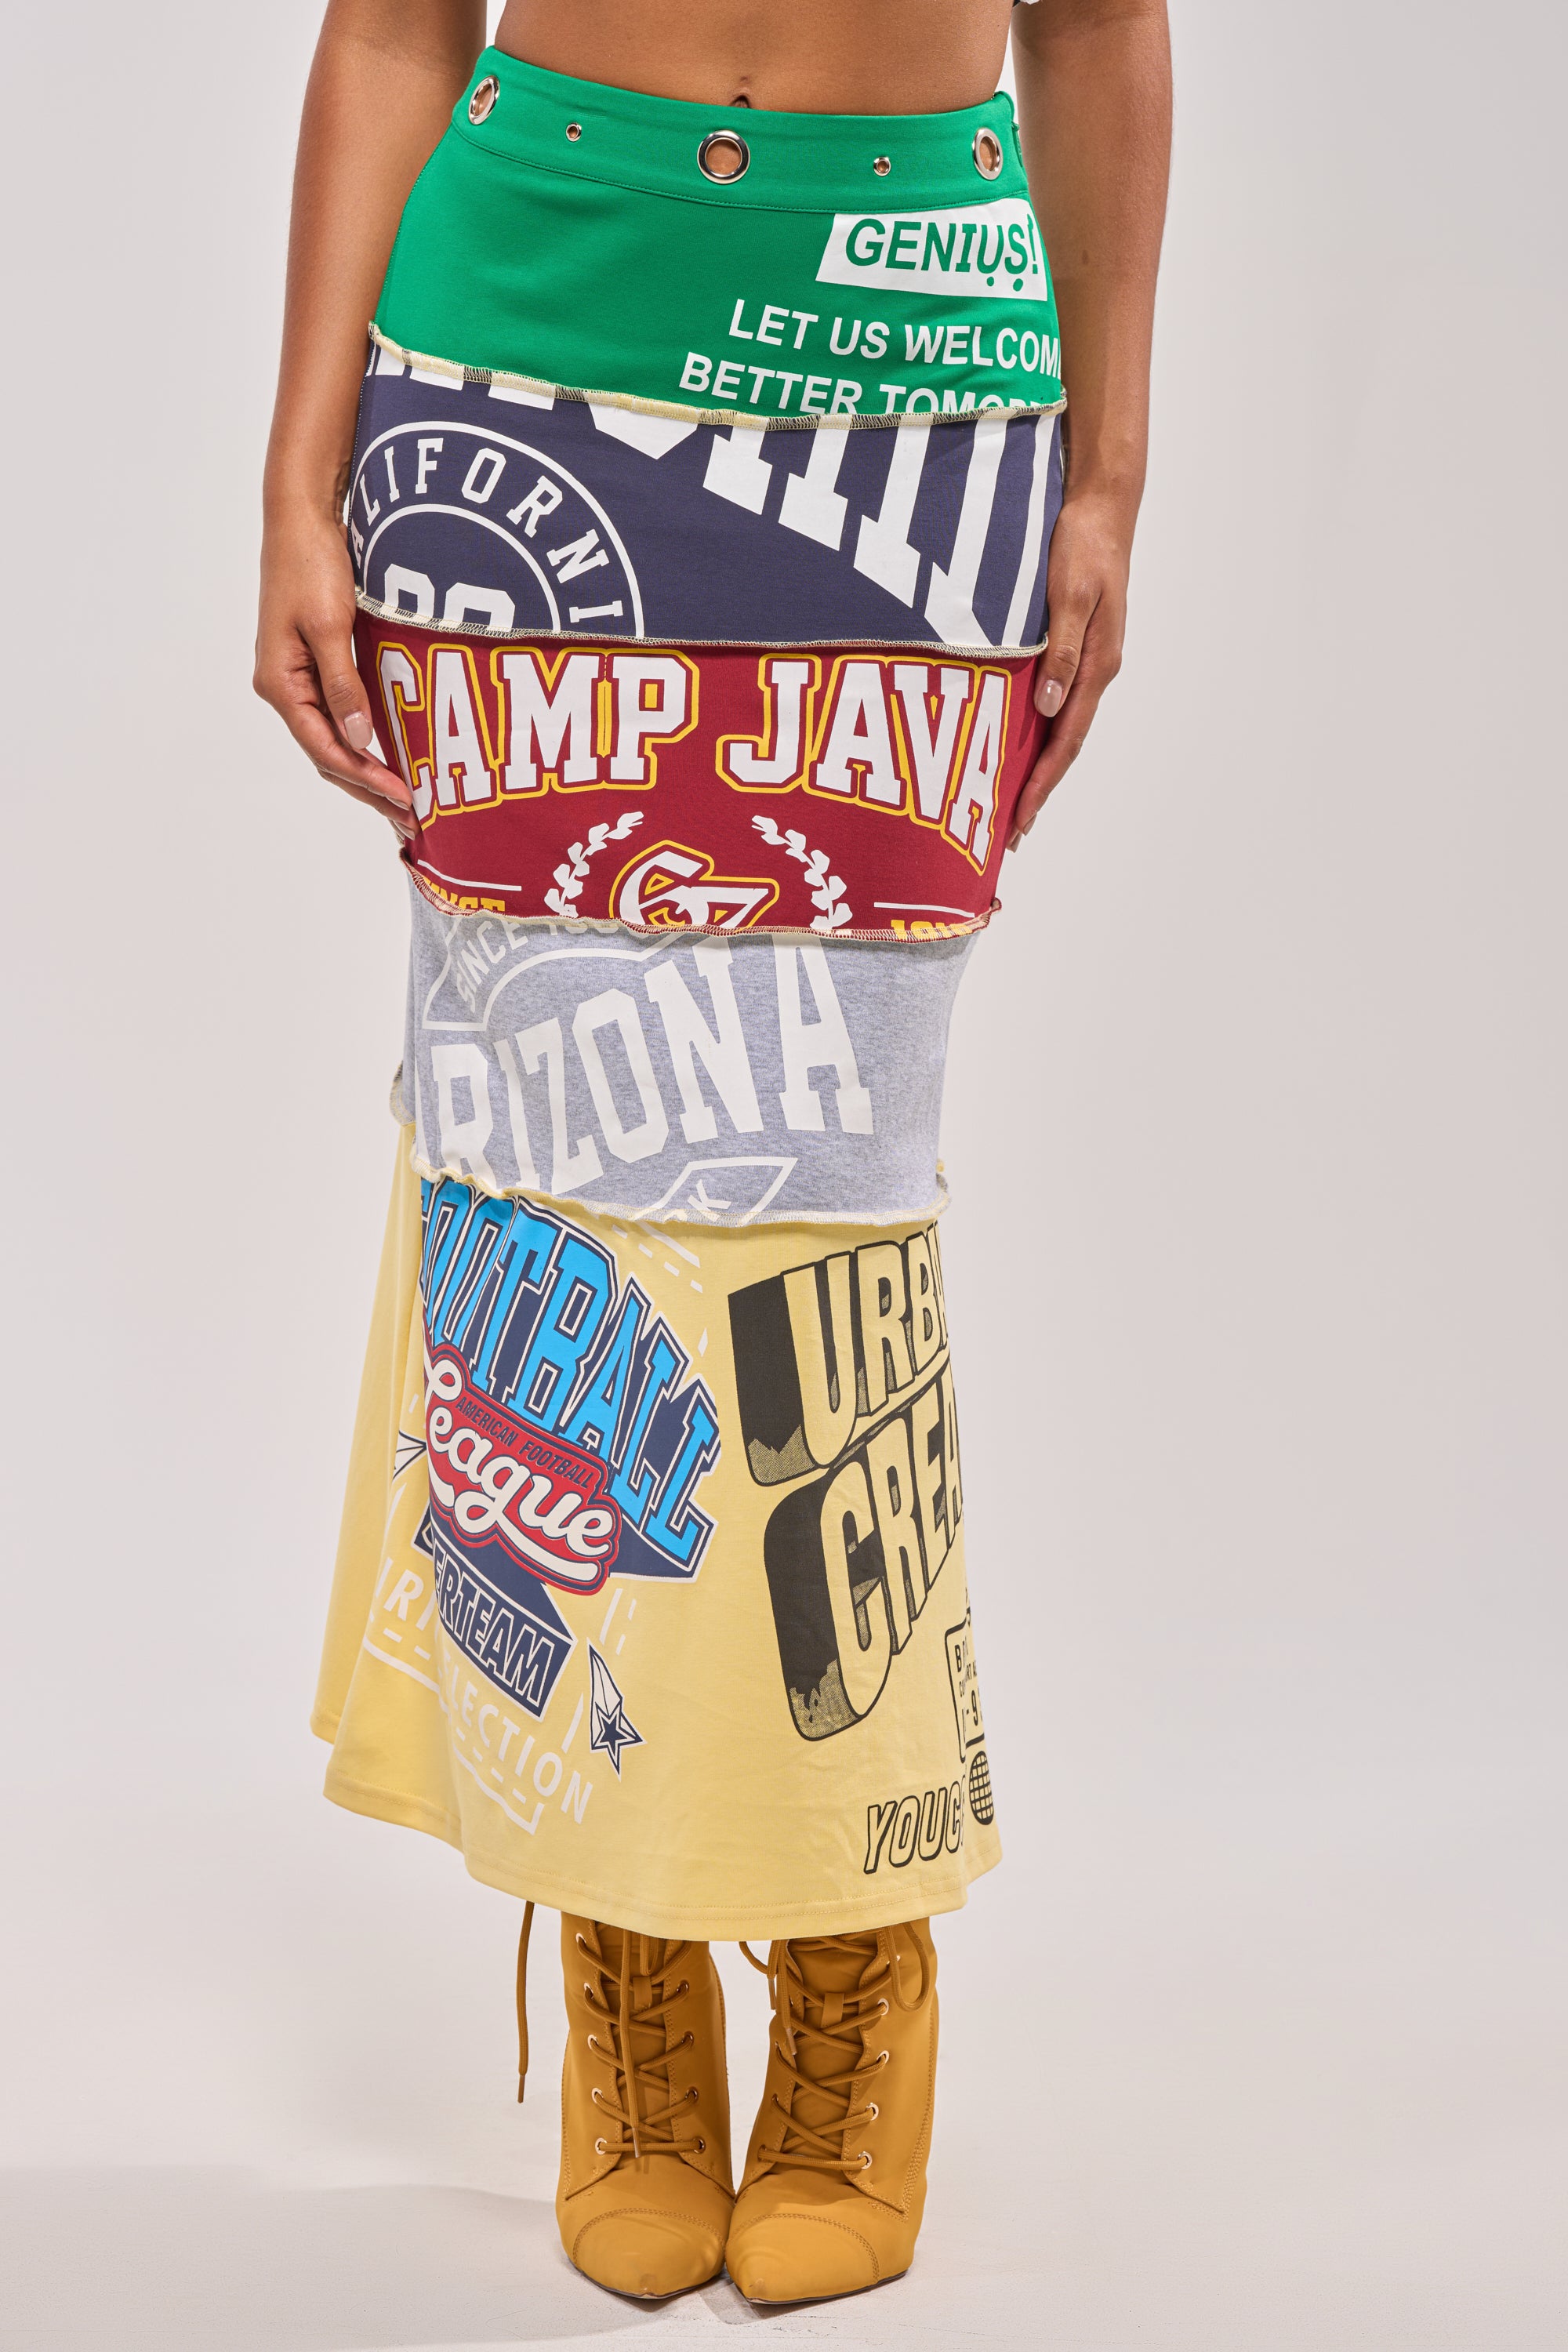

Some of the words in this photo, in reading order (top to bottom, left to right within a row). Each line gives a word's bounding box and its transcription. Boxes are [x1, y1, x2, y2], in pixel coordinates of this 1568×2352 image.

[679, 351, 863, 416] BETTER
[728, 299, 818, 350] LET
[829, 317, 891, 359] US
[904, 323, 1061, 381] WELCOM
[378, 644, 695, 826] CAMP
[720, 655, 1009, 871] JAVA
[457, 920, 528, 1013] SINCE
[416, 933, 873, 1194] RIZONA
[456, 1397, 518, 1447] AMERICAN
[519, 1440, 593, 1489] FOOTBALL
[430, 1537, 555, 1708] ERTEAM
[863, 1777, 965, 1875] YOUC
